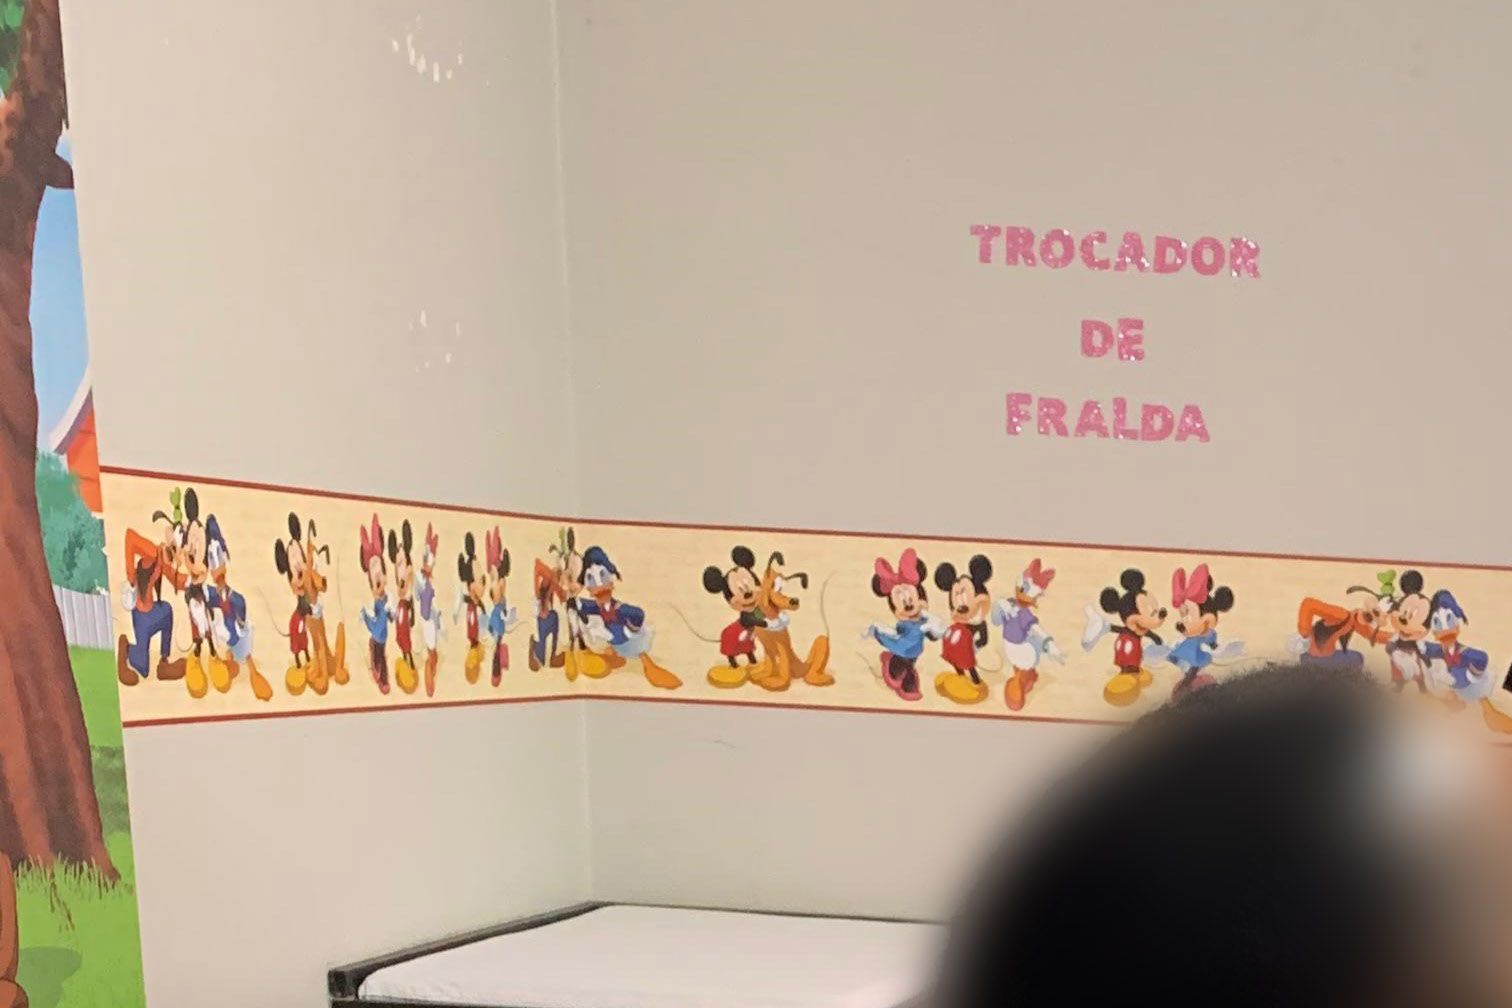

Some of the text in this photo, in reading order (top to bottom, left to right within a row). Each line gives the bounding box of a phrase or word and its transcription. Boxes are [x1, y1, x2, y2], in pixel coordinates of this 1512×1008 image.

[970, 224, 1260, 278] TROCADOR
[1081, 318, 1144, 361] DE
[1006, 393, 1210, 442] FRALDA
